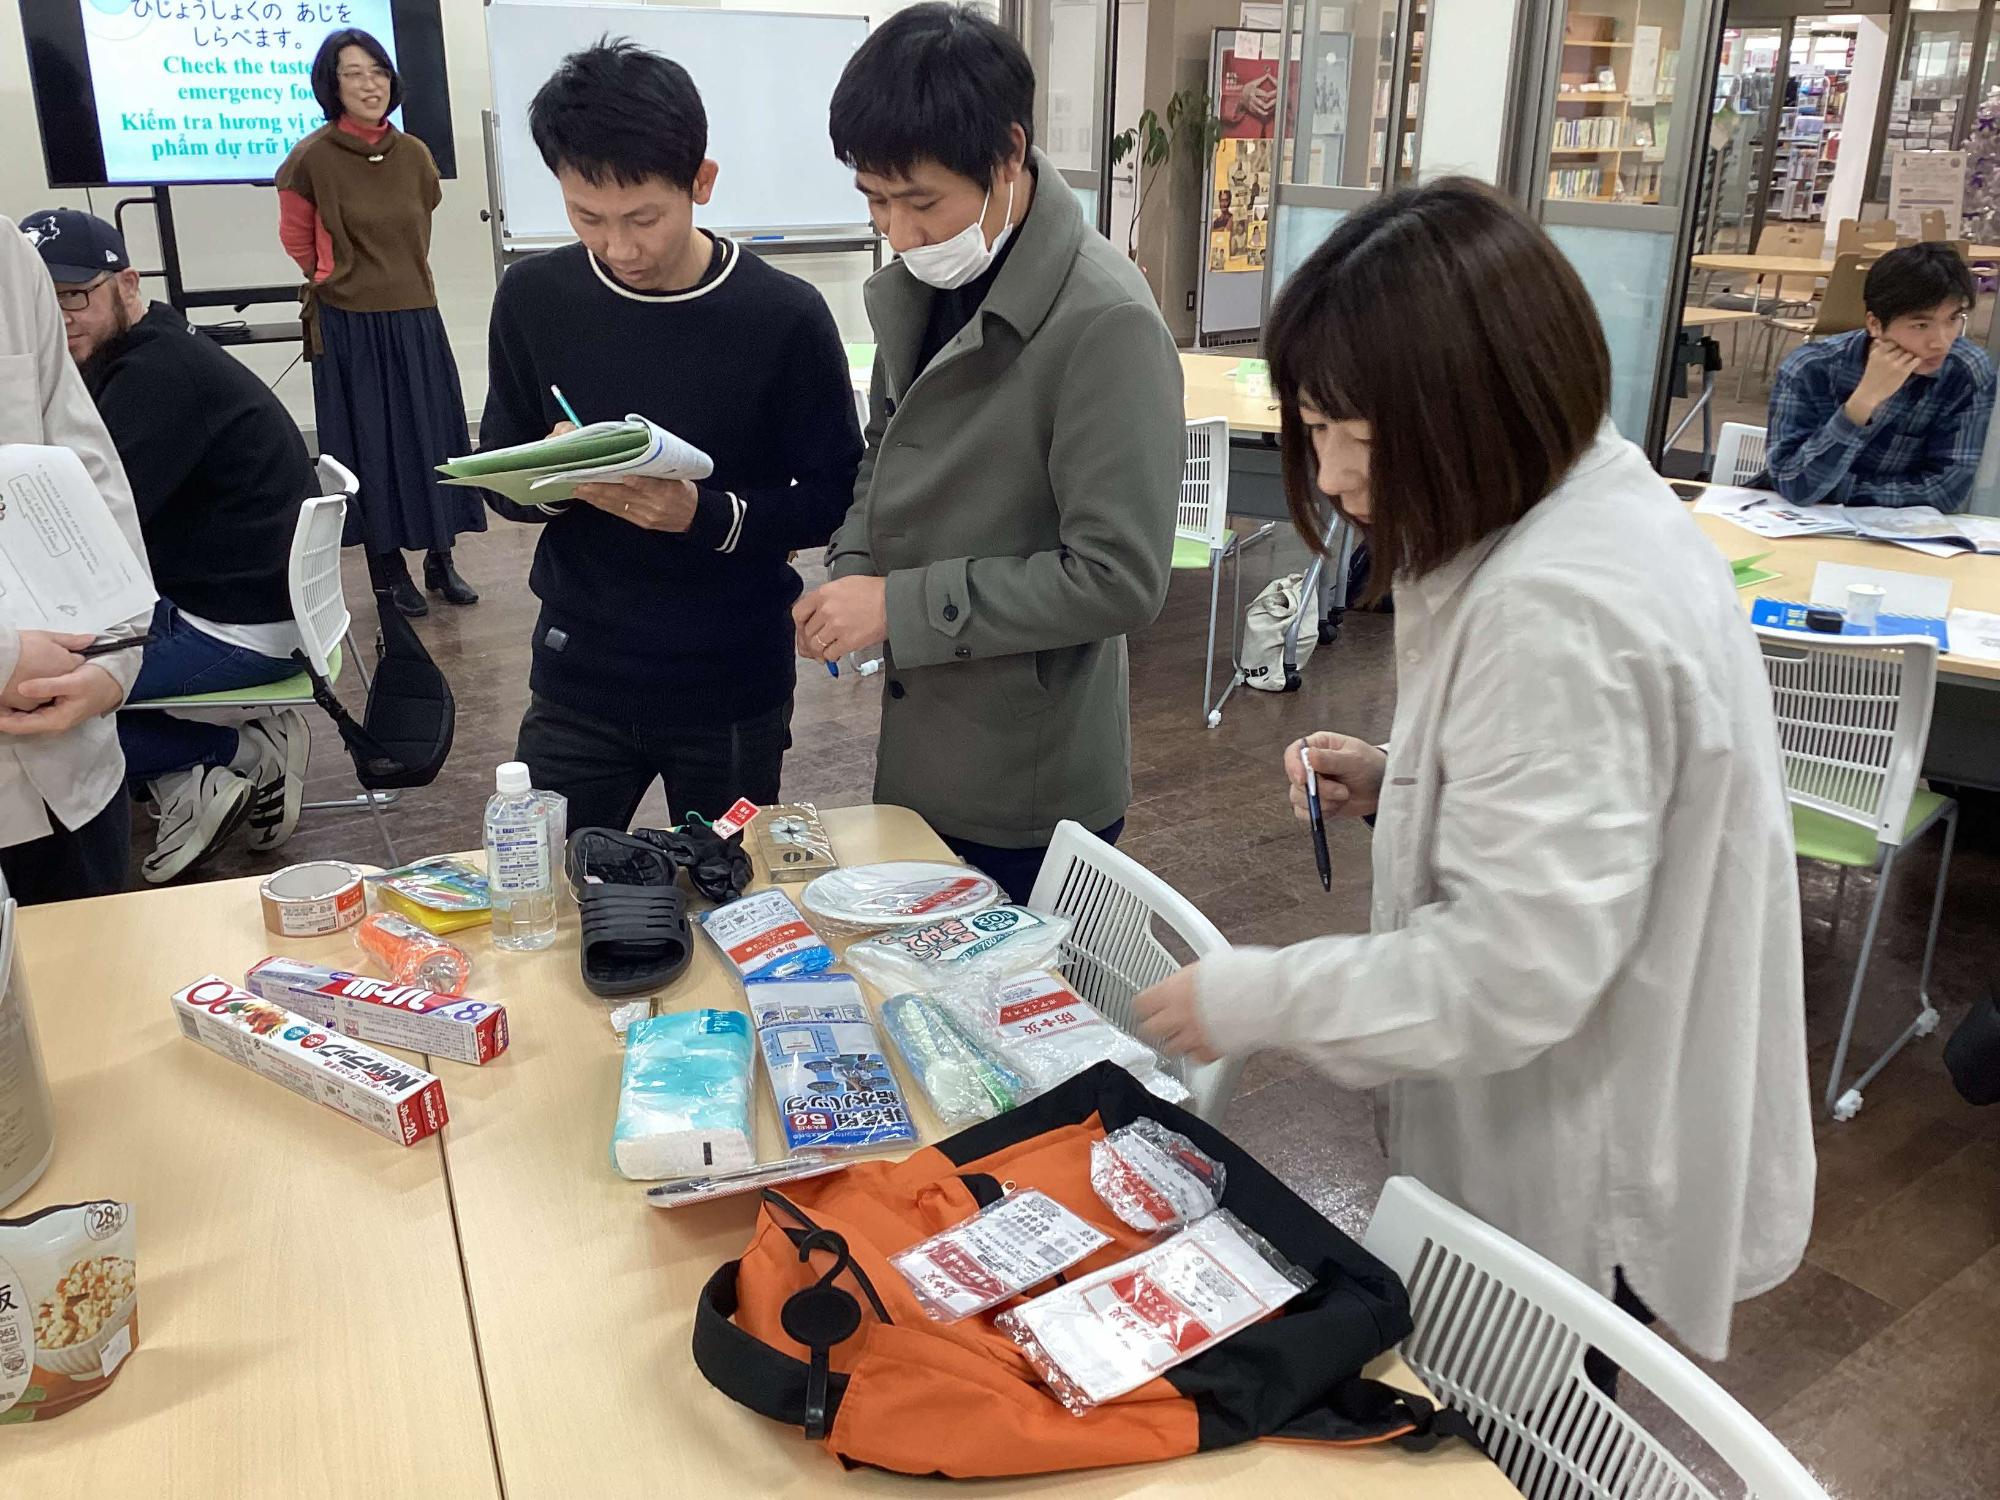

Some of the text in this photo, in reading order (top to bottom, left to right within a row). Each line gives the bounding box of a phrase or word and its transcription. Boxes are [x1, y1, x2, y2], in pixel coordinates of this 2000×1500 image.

[297, 2, 351, 23] あじを
[194, 27, 302, 49] しらべます。
[163, 56, 227, 75] Check
[234, 57, 264, 75] the
[178, 85, 283, 104] emergency
[121, 108, 176, 131] Kiểm
[183, 115, 212, 131] tra
[219, 113, 283, 134] hương
[288, 113, 305, 135] vị
[151, 133, 208, 161] phẩm
[215, 138, 242, 160] dự
[248, 137, 277, 155] trữ
[783, 1091, 903, 1116] 給水バッグ
